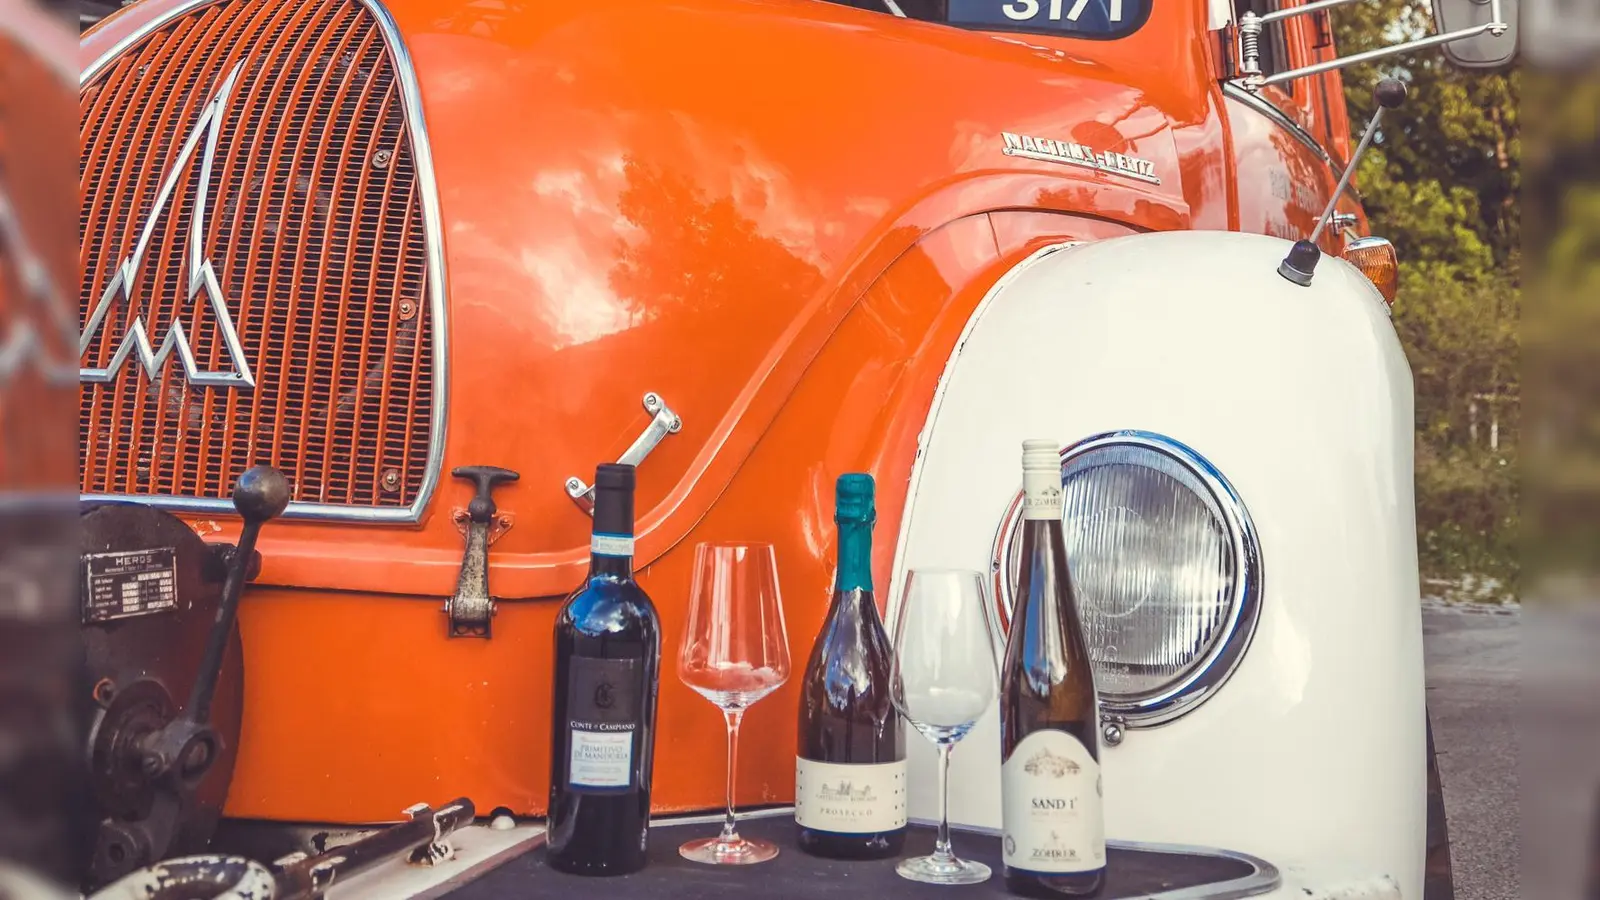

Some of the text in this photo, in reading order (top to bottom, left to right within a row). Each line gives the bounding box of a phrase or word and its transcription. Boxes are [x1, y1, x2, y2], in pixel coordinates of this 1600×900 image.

[116, 555, 152, 565] HEROS
[570, 721, 592, 730] CONTE
[1031, 798, 1066, 809] SAND
[820, 807, 872, 816] PROSECCO
